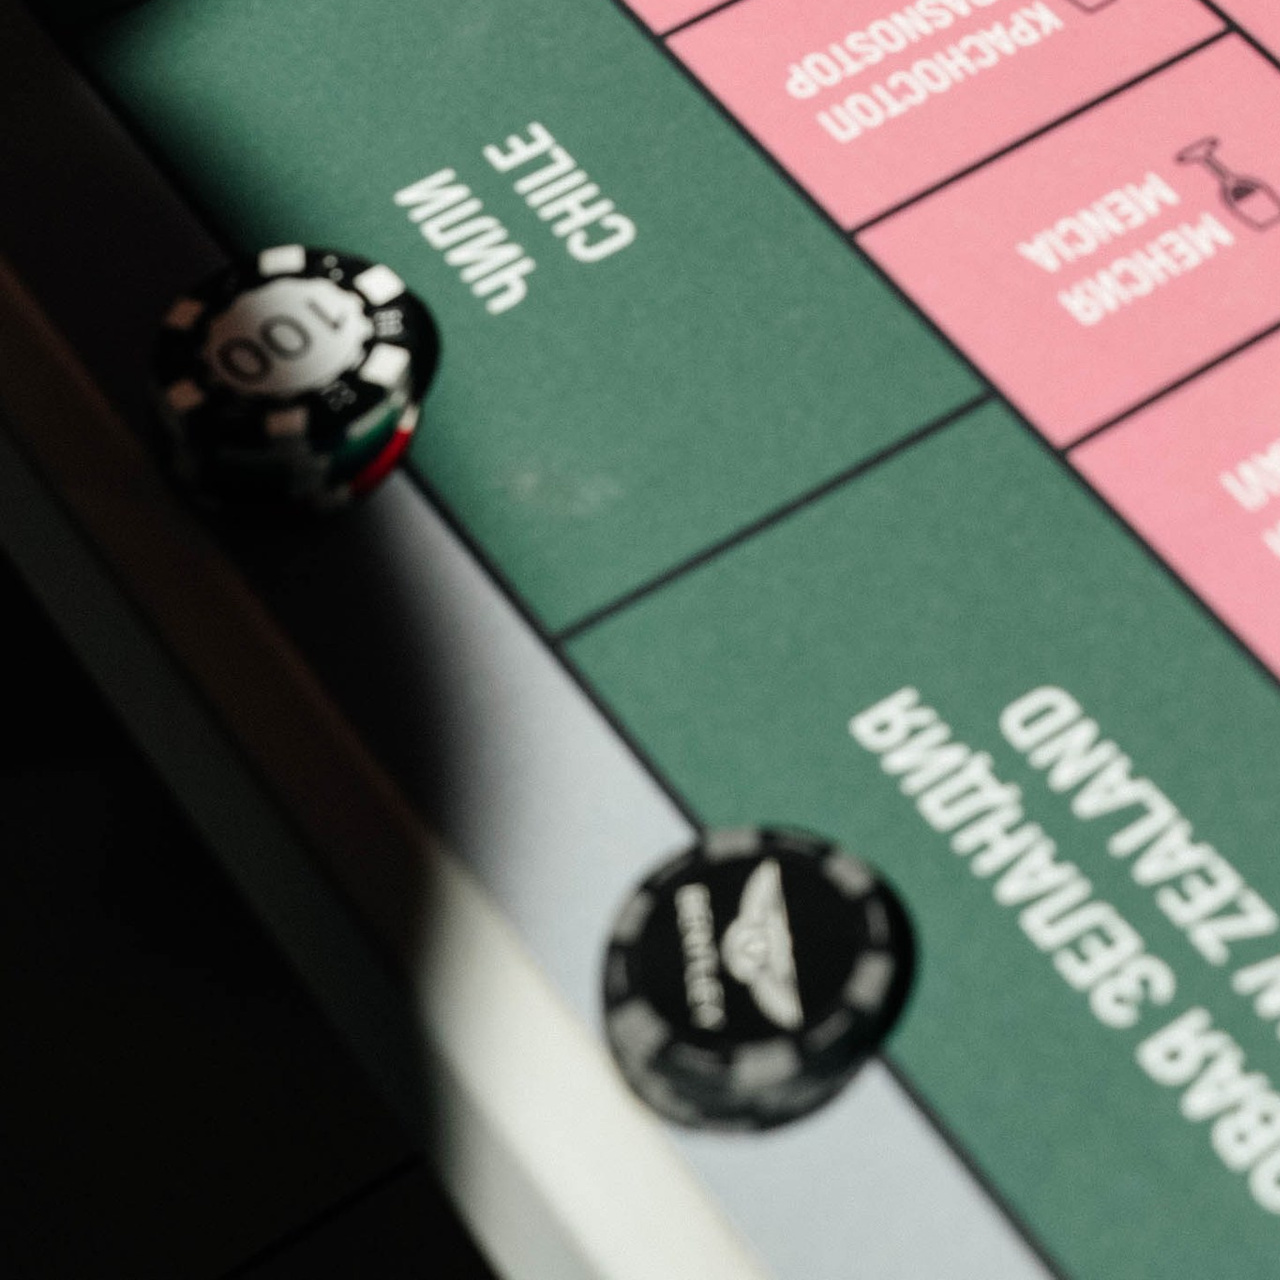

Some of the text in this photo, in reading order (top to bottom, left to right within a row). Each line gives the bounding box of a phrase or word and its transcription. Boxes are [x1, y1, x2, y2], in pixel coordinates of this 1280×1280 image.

[816, 0, 1064, 144] КРАСНОСТОП
[394, 167, 537, 315] ЧИЛИ
[482, 121, 637, 264] CHILE
[1015, 171, 1181, 274] MENCIA
[1057, 211, 1236, 326] МЕНСИЯ
[216, 298, 348, 386] 100
[847, 685, 1177, 1030] ЗЕЛАНДИЯ
[999, 684, 1280, 966] ZEALAND
